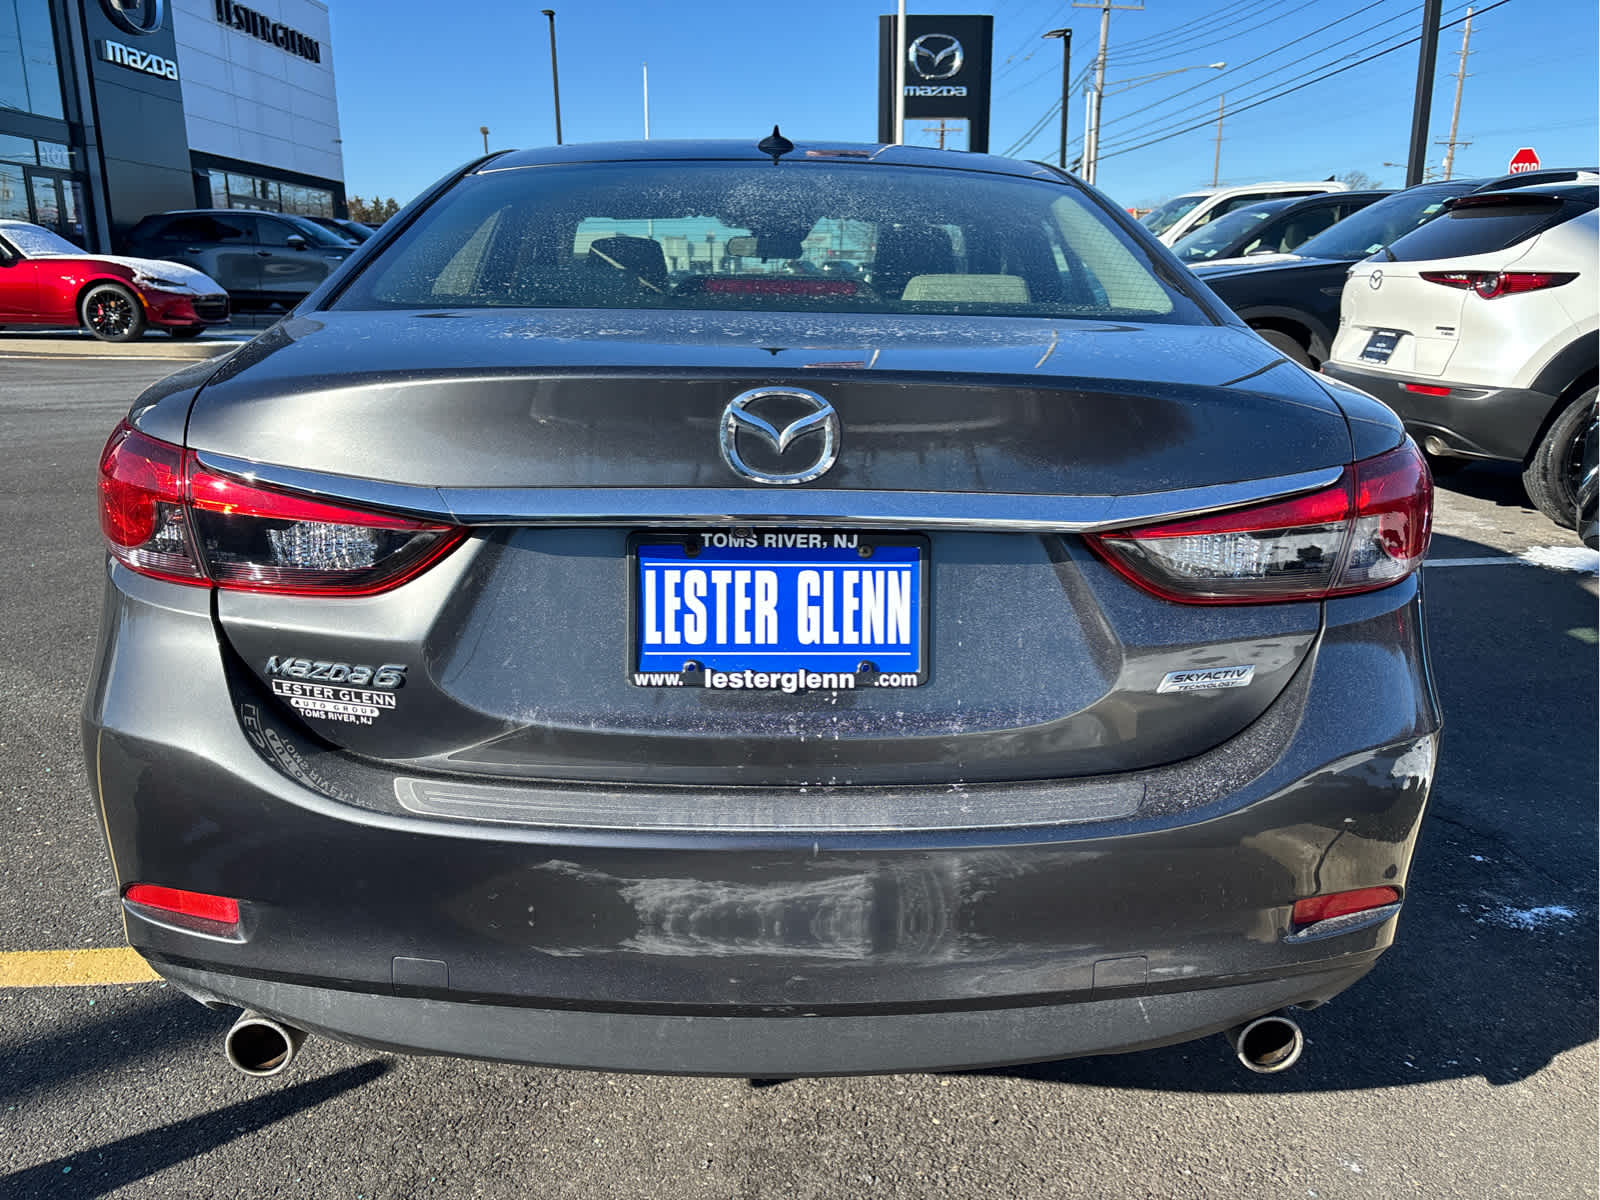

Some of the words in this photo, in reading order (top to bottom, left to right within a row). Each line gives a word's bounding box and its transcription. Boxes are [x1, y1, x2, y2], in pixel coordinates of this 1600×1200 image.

[105, 39, 178, 80] mazda
[903, 85, 968, 97] mazda
[701, 533, 758, 548] TOMS
[764, 533, 828, 549] RIVER,
[833, 534, 858, 548] NJ
[645, 569, 778, 645] LESTER
[797, 569, 911, 645] GLENN
[634, 673, 683, 686] www.
[704, 669, 855, 693] lesterglenn
[874, 672, 918, 687] .com
[1173, 668, 1248, 683] SKYACTIV
[272, 681, 334, 699] LESTER
[340, 690, 396, 706] GLENN
[294, 698, 326, 709] AUTO
[333, 704, 376, 715] GROUP
[299, 708, 326, 720] TOMS
[327, 711, 360, 725] RIVER,
[360, 716, 373, 725] NJ
